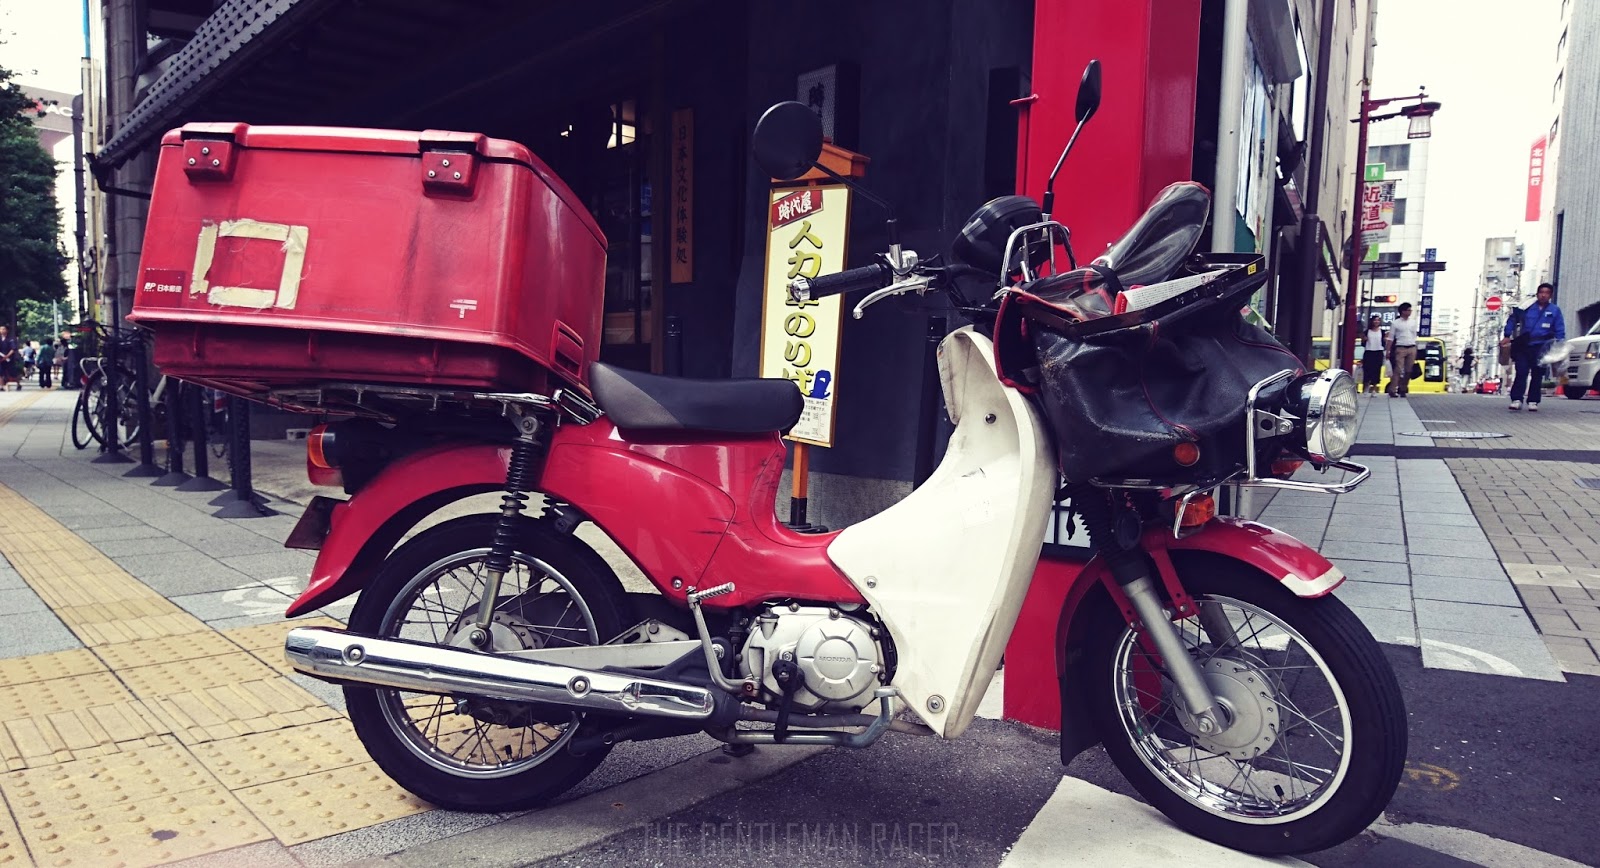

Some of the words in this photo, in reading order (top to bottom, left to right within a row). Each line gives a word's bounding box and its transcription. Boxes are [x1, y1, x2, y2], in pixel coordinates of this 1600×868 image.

[676, 125, 688, 263] 日本文化体験処
[778, 190, 813, 221] 時代屋
[818, 655, 854, 664] HONDA
